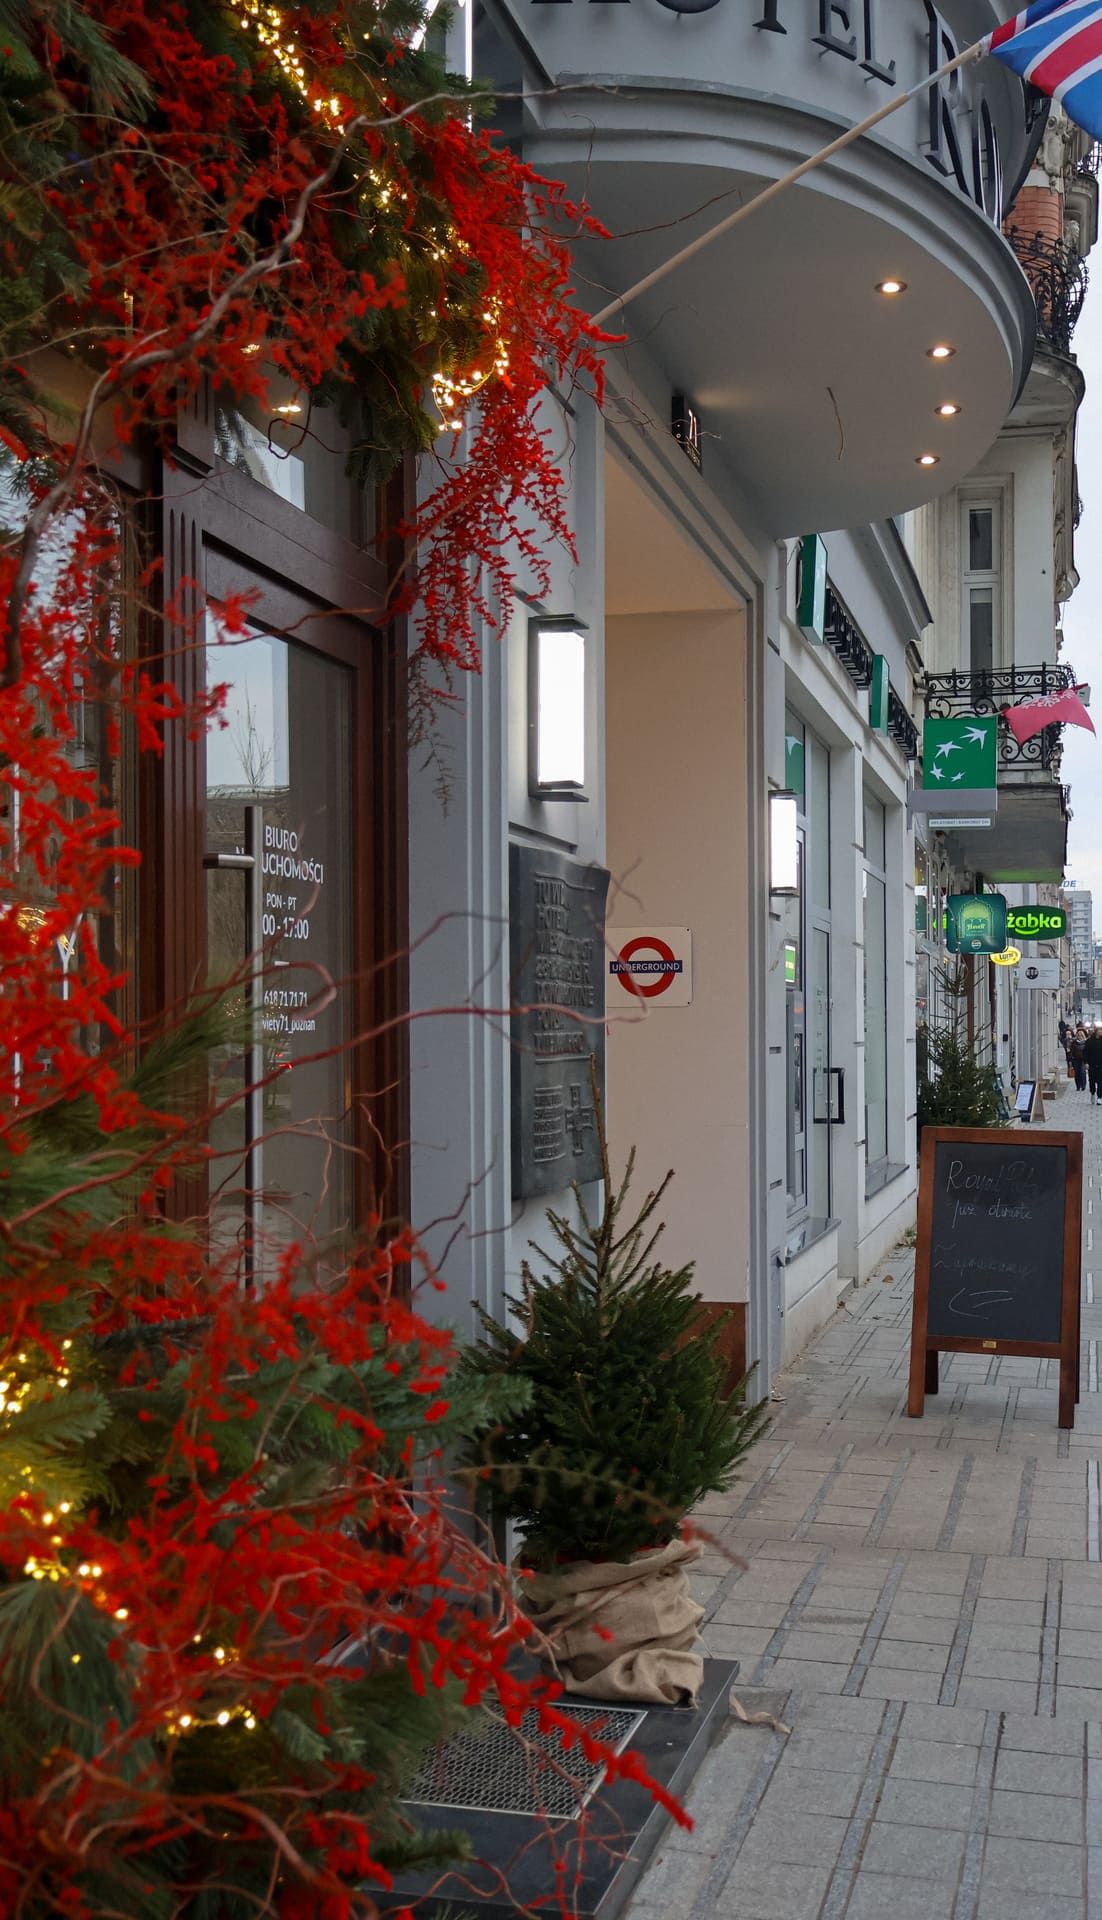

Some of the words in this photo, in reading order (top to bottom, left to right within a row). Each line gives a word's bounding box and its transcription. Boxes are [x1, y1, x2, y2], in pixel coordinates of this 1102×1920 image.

[265, 825, 298, 852] BIURO
[266, 892, 283, 909] PON
[287, 895, 298, 911] PT
[283, 916, 310, 940] 17:00
[1006, 912, 1063, 929] żabka
[611, 962, 680, 972] UNDERGROUND
[263, 989, 309, 1008] 618717171
